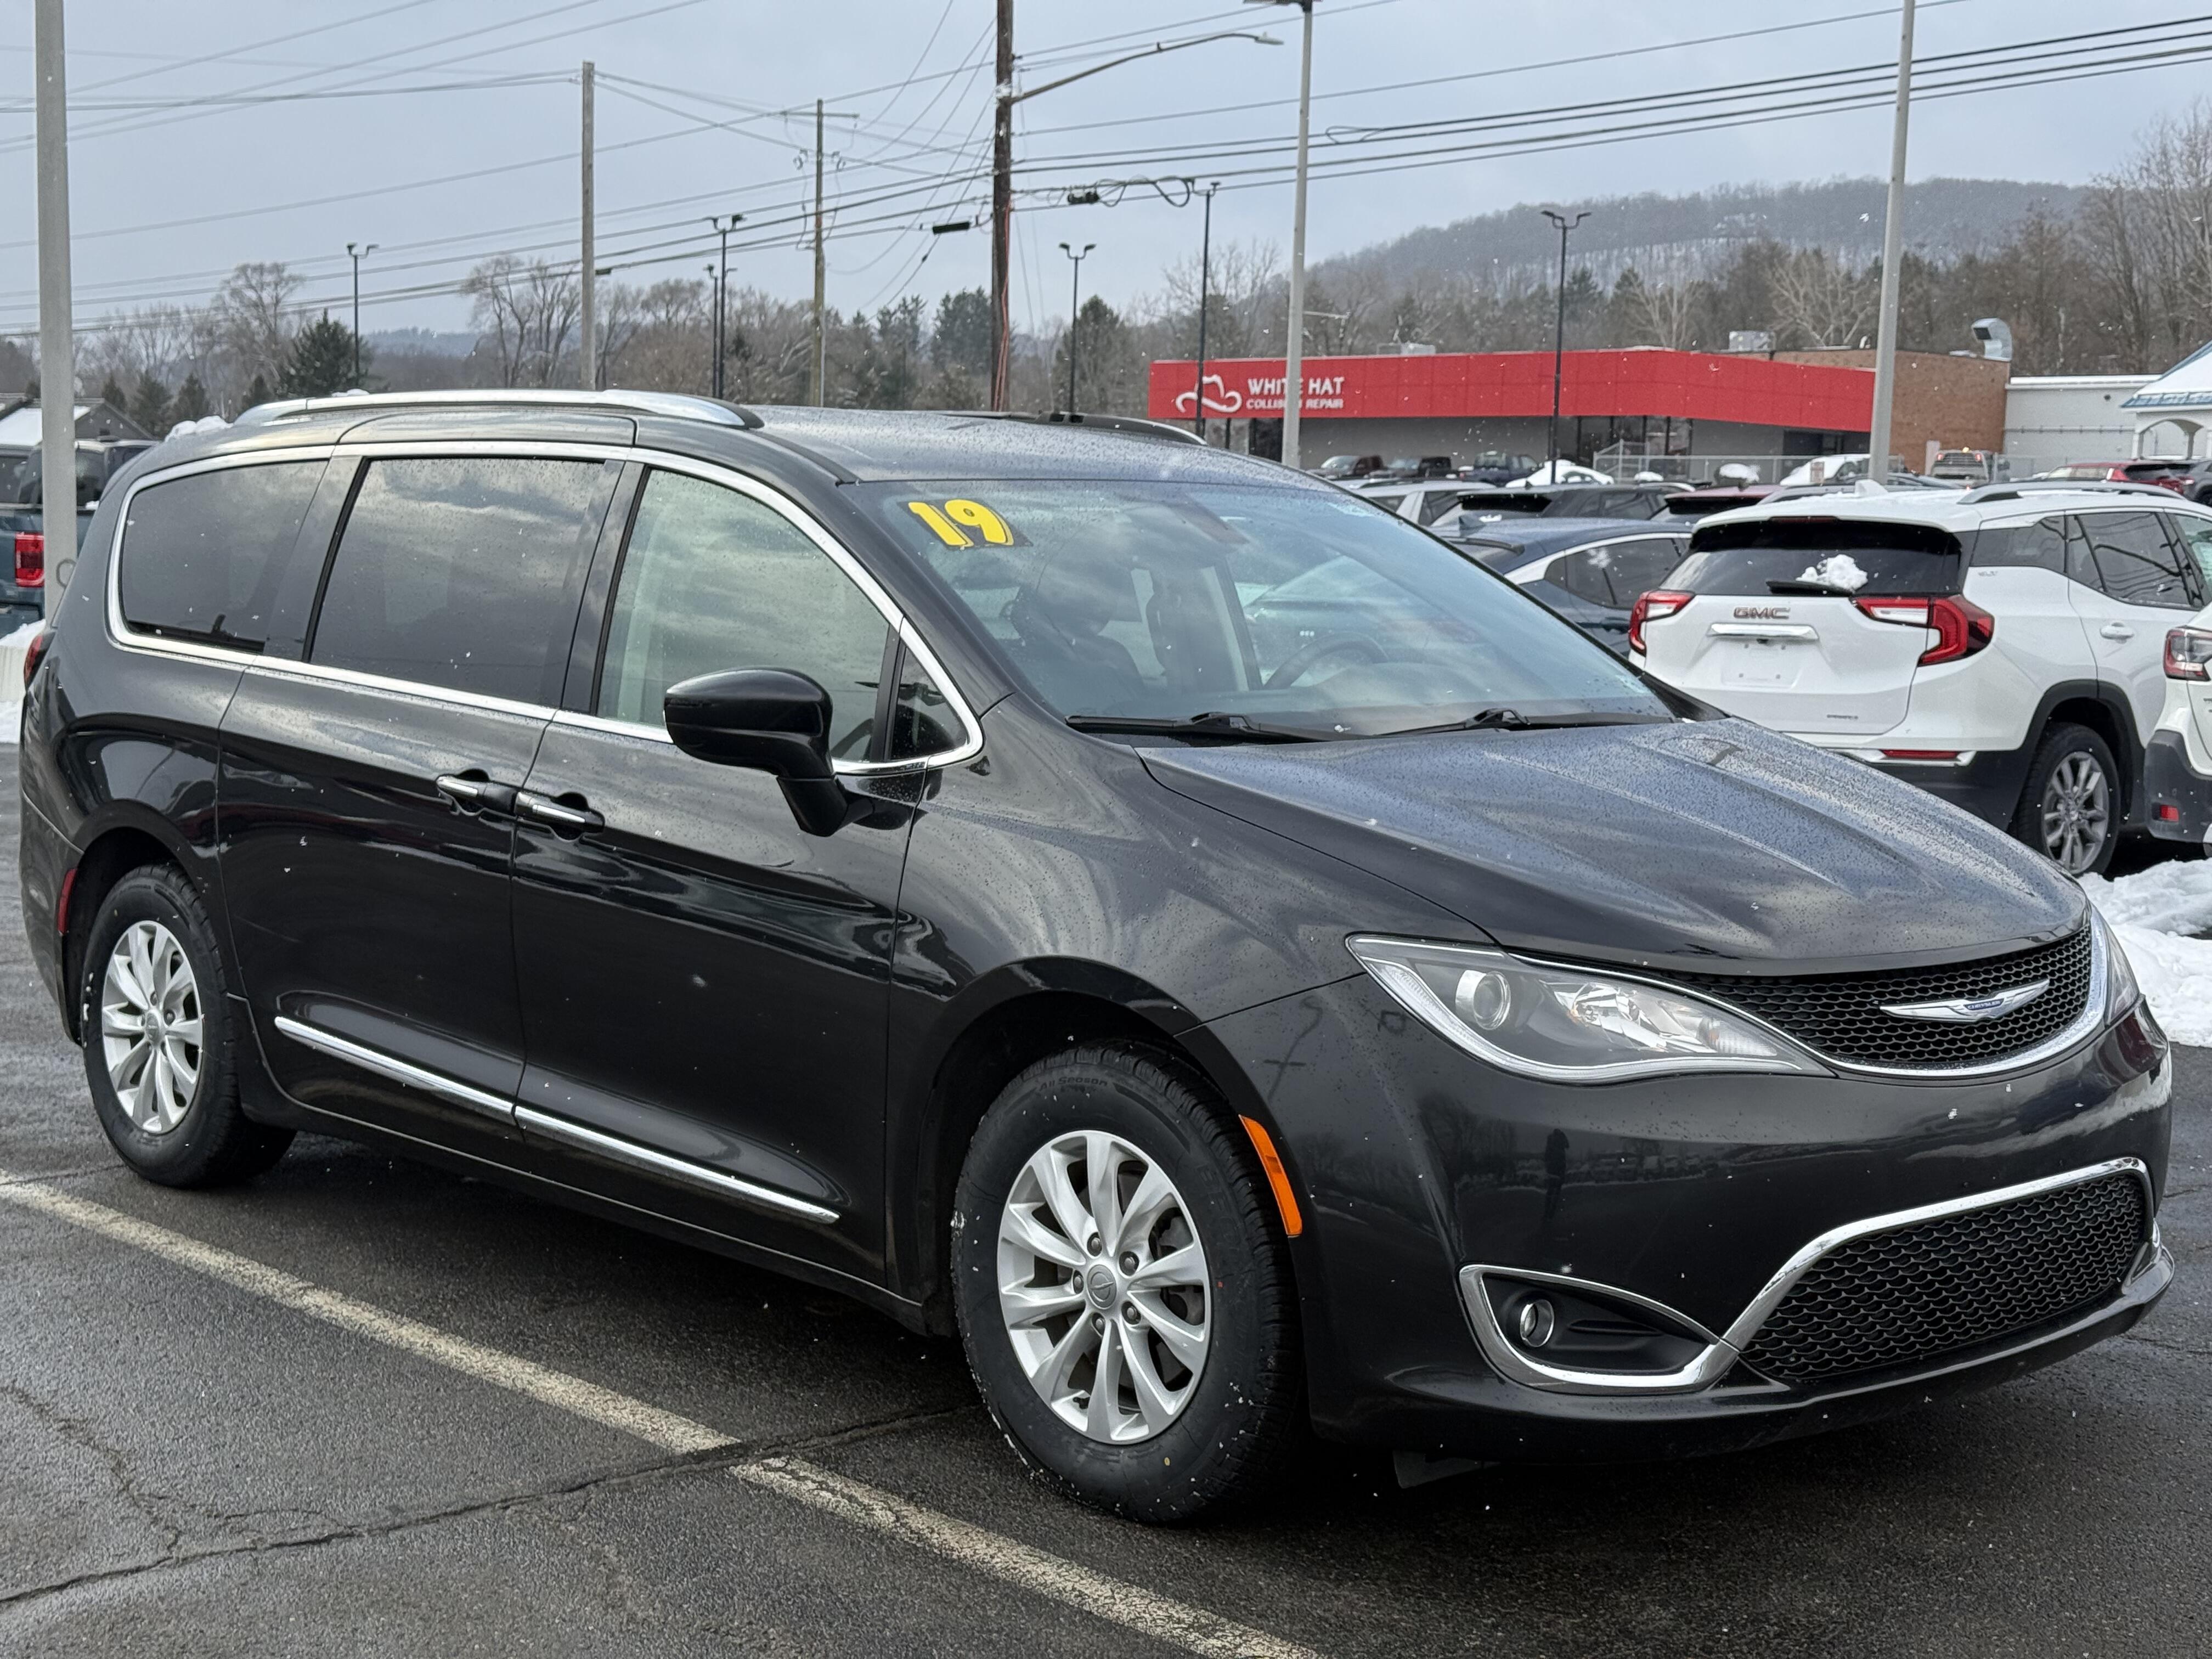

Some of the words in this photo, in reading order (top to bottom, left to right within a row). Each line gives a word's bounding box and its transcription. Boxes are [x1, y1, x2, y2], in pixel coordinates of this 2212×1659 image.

[1308, 376, 1345, 395] HAT
[1246, 398, 1302, 409] COLLIS
[1306, 398, 1344, 409] REPAIR
[908, 499, 1014, 547] 19
[1734, 607, 1791, 619] GMC
[1040, 1080, 1056, 1091] All
